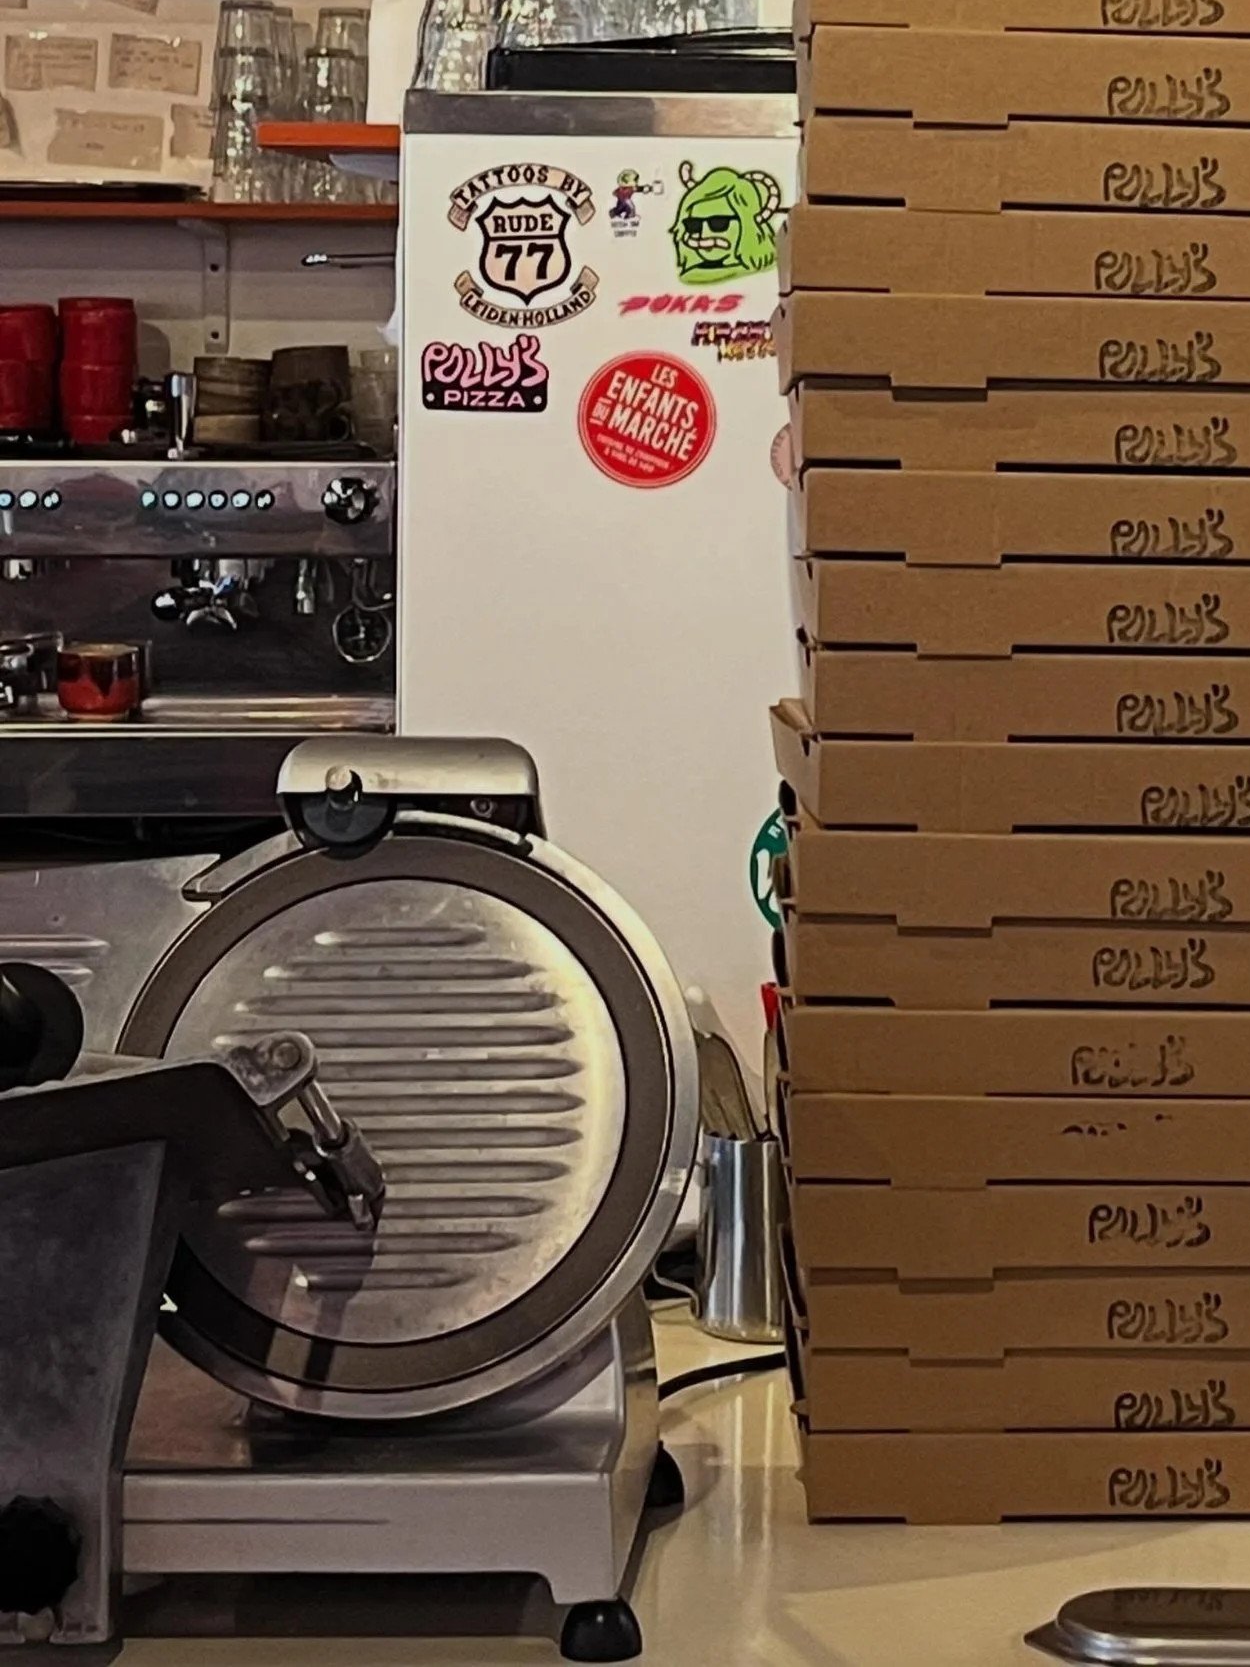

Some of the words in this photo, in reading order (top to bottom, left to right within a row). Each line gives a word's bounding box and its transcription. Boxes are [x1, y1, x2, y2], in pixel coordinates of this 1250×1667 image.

[453, 164, 550, 206] TATTOOS
[559, 174, 589, 199] BY
[493, 213, 554, 234] RUDE
[494, 242, 554, 282] 77
[423, 334, 548, 389] POLLY'S
[650, 363, 679, 389] LES
[443, 389, 527, 408] PIZZA
[606, 370, 700, 431] ENFANTS
[607, 403, 698, 462] MARCHÉ
